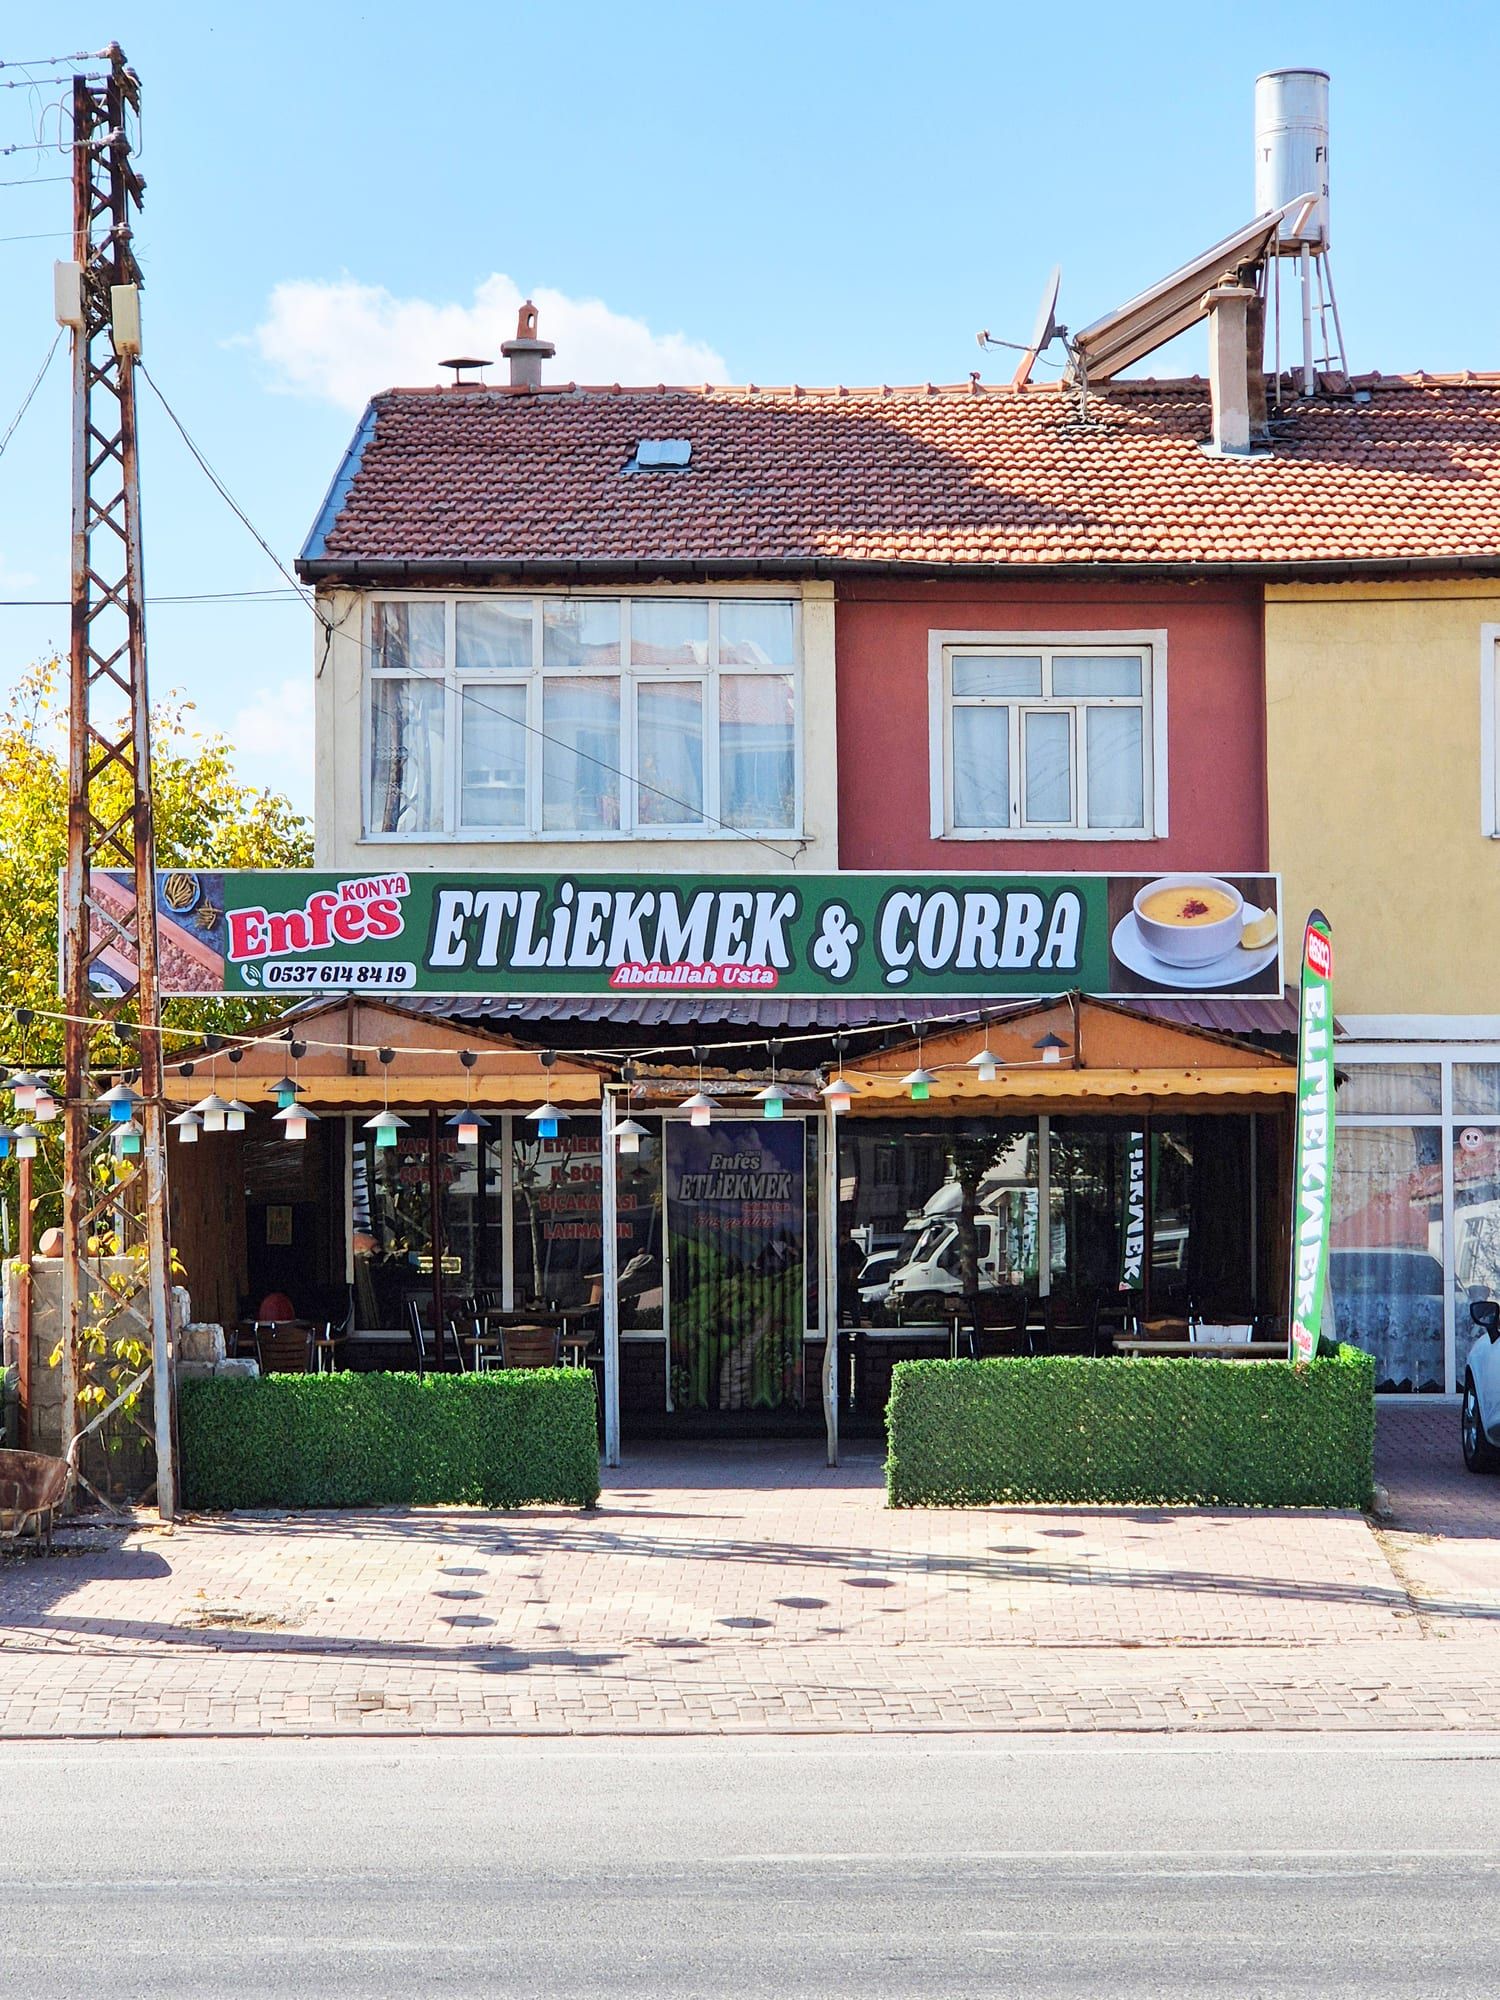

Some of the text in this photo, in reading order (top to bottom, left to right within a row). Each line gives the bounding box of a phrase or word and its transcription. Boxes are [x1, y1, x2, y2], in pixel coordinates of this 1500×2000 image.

[341, 876, 407, 902] KONYA
[229, 894, 401, 959] Enfes
[812, 904, 859, 978] &
[879, 891, 1080, 984] ÇORBA
[268, 966, 407, 983] 0537 614 84 19
[613, 965, 774, 984] Abdullah Usta
[709, 1152, 761, 1170] Enfes
[570, 1163, 624, 1182] BÖRK
[543, 1223, 633, 1239] LAHMAN
